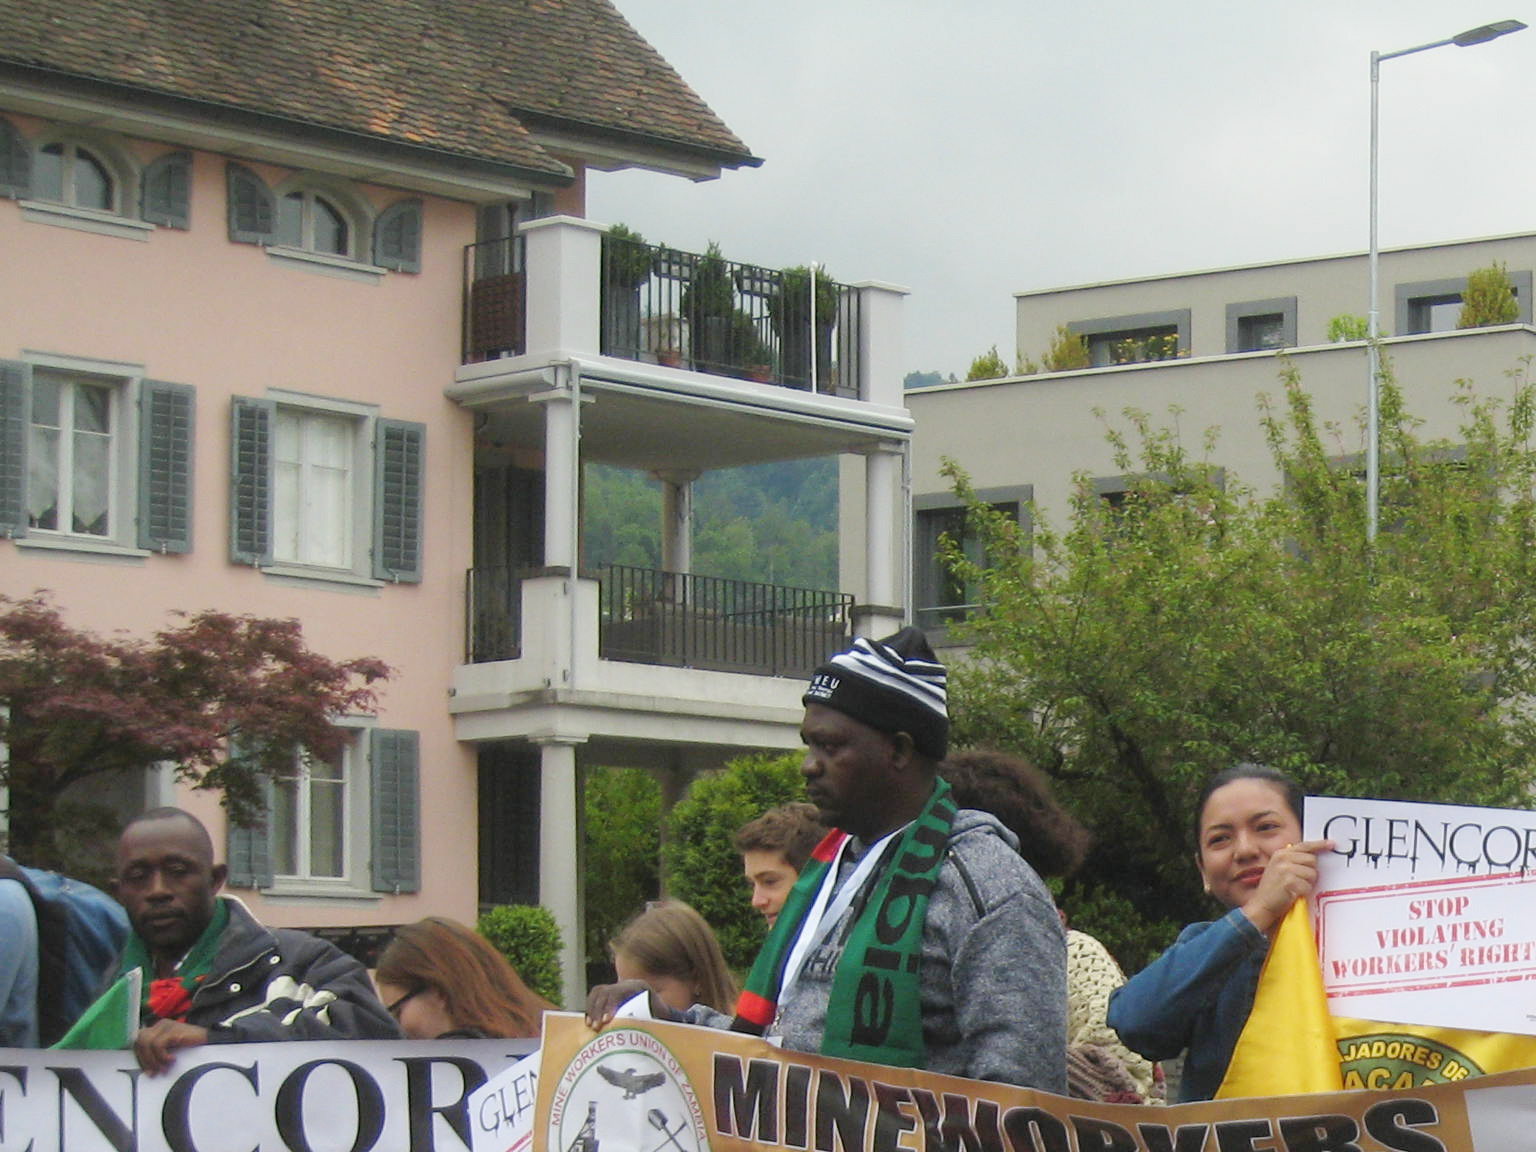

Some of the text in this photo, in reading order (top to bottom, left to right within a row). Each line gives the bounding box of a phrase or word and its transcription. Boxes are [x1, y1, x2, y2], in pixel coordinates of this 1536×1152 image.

[1409, 896, 1469, 920] STOP
[1377, 918, 1504, 949] VIOLATING
[1332, 944, 1456, 979] WORKERS'
[1337, 1039, 1470, 1081] JADORES DE
[552, 1033, 707, 1141] MINE WORKERS UNION OF ZAMBIA
